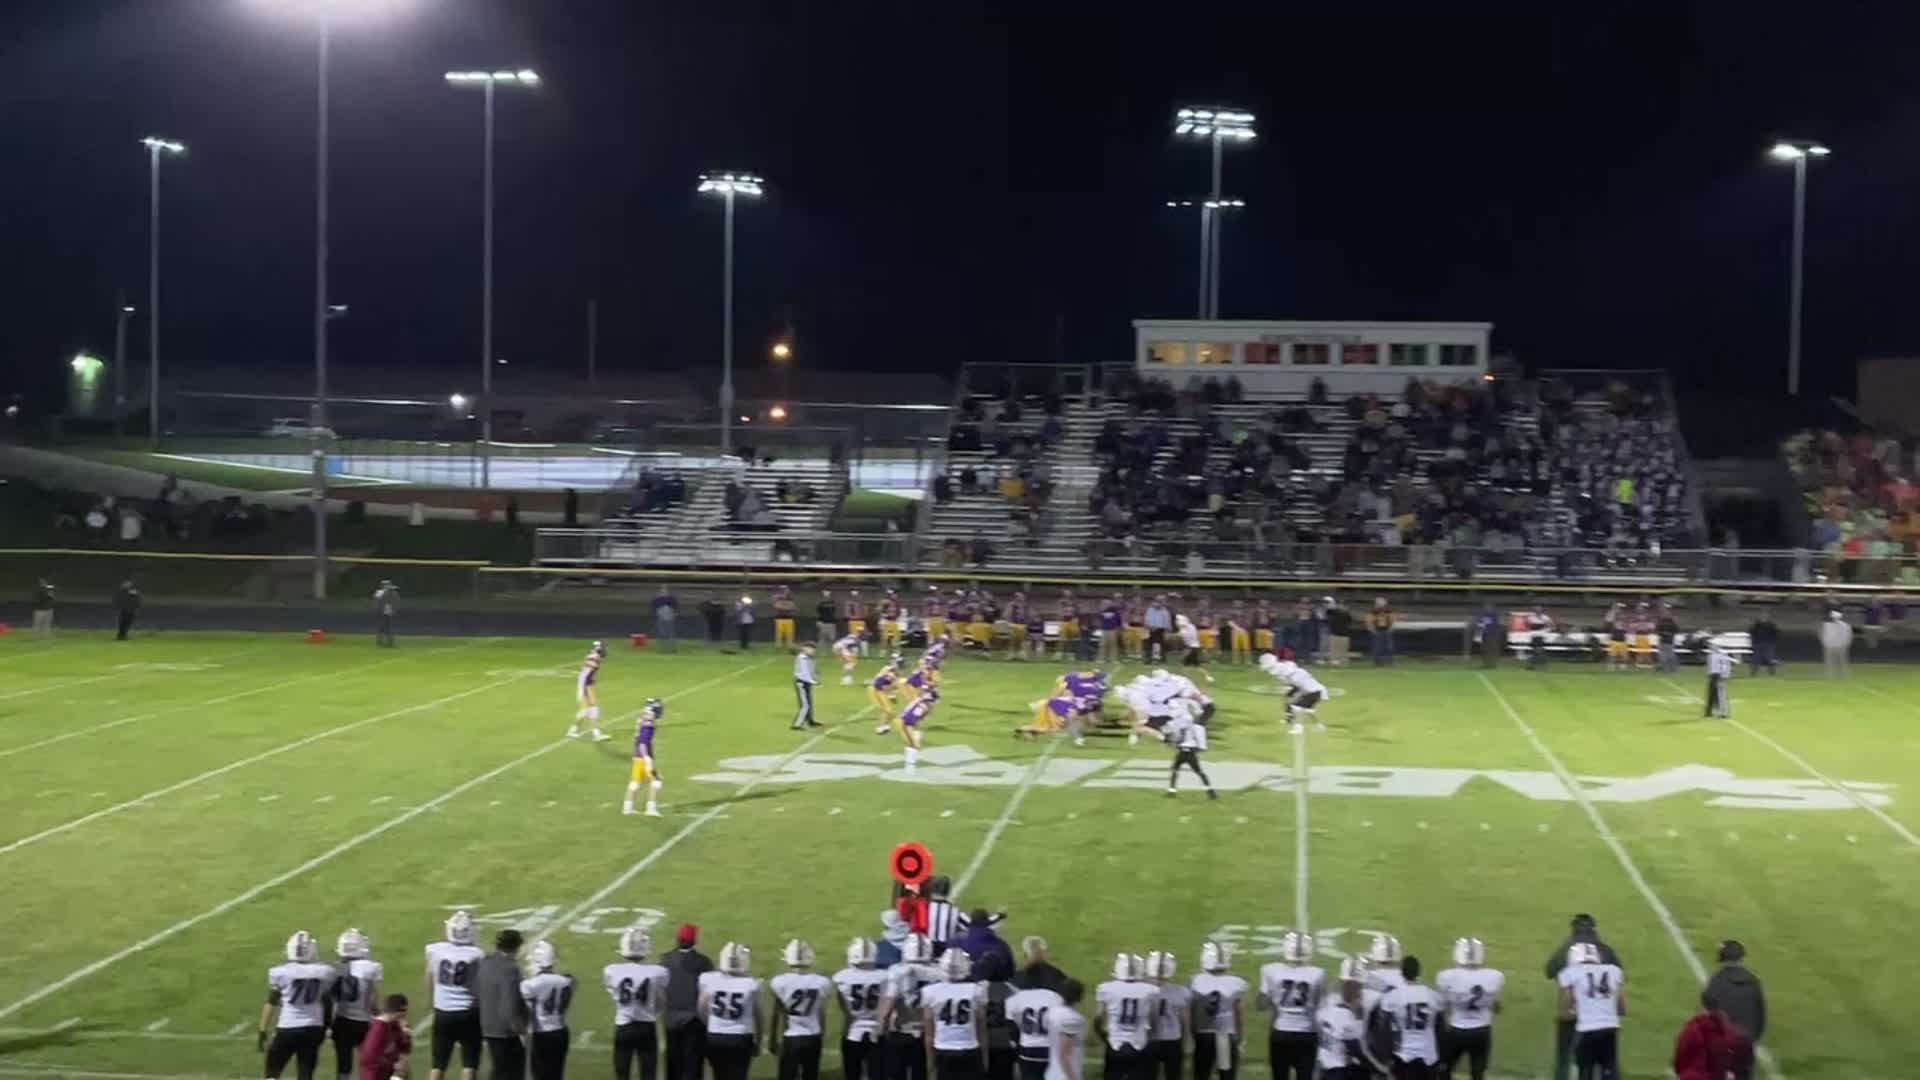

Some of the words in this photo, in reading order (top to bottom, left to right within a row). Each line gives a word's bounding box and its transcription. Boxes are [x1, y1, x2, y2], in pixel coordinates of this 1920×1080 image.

[619, 977, 650, 1006] 64
[851, 984, 880, 1011] 56
[1280, 979, 1310, 1007] 73
[1469, 984, 1483, 1011] 2
[1586, 972, 1610, 999] 14
[712, 991, 744, 1020] 55
[790, 988, 818, 1017] 27
[940, 999, 970, 1026] 46
[1404, 1002, 1429, 1030] 15
